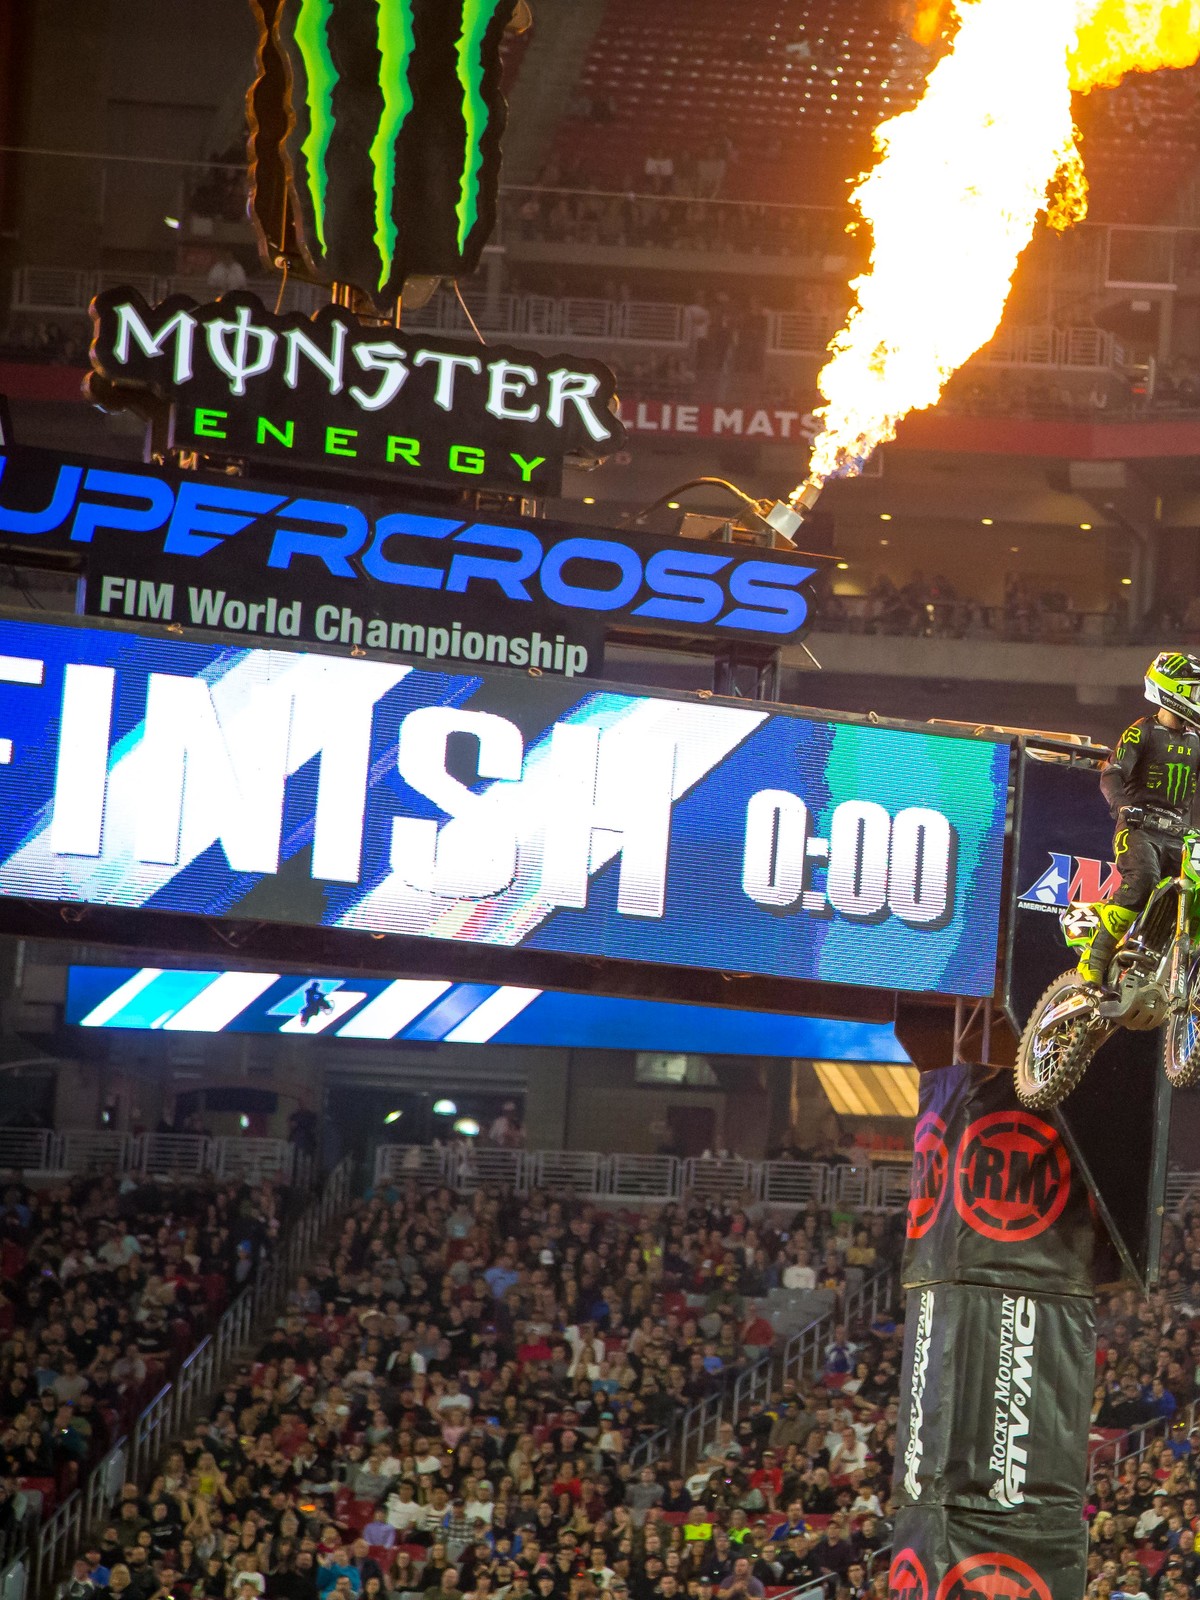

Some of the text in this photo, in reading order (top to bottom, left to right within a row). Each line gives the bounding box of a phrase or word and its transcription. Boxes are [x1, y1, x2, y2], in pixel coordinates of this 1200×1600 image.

[111, 303, 611, 442] MONSTER
[194, 408, 547, 482] ENERGY
[100, 575, 590, 677] FIM World Championship
[1167, 744, 1193, 756] FOX
[743, 788, 951, 922] 0:00
[1017, 901, 1058, 914] AMERICAN
[909, 1291, 928, 1402] MOUNTAIN
[994, 1293, 1016, 1405] MOUNTAIN
